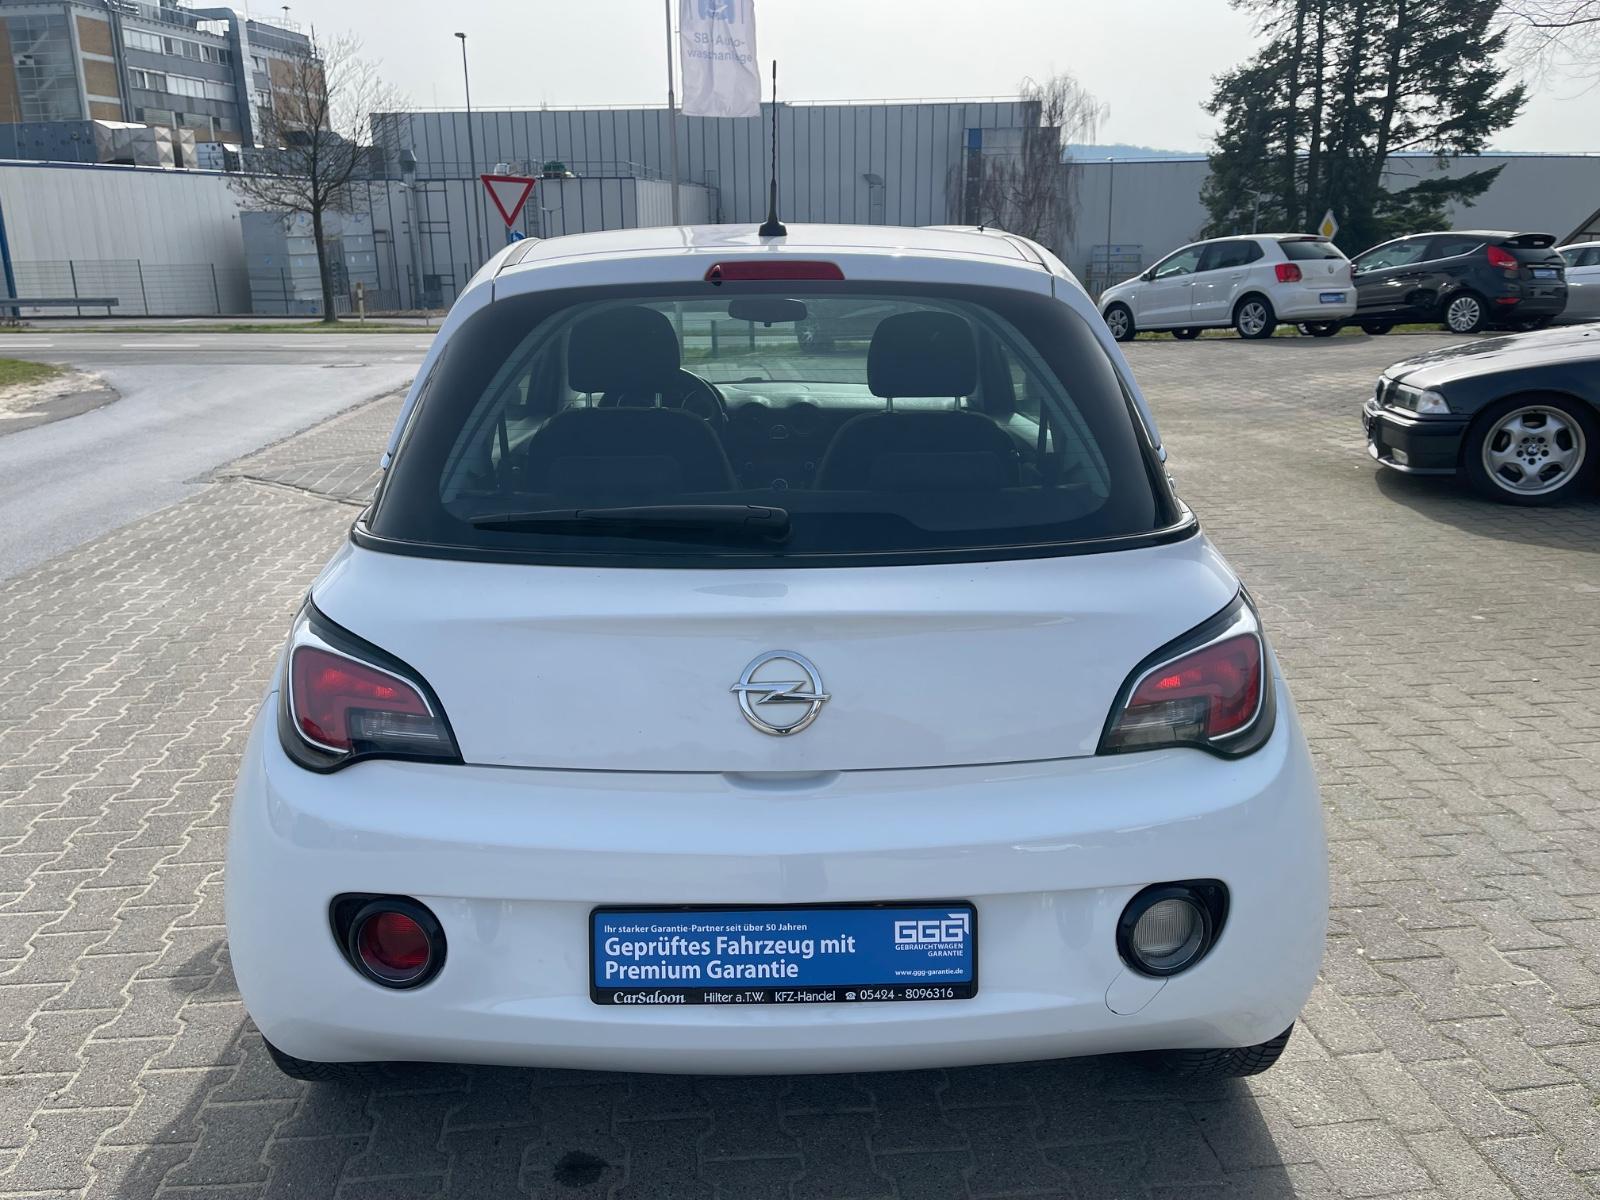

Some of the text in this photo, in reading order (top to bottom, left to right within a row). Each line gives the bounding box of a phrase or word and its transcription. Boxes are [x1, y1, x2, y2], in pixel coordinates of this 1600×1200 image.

[604, 923, 807, 933] Ihr starker Garantie-Partner seit über 50 Jahren
[894, 920, 963, 943] GGG
[604, 934, 856, 960] Geprüftes Fahrzeug mit
[895, 943, 964, 951] GEBRAUCHTWAGEN
[605, 959, 799, 980] Premium Garantie
[895, 968, 964, 977] www.ggg-garantie.de
[613, 990, 686, 1004] CarSaloon
[704, 992, 733, 1003] Hilter
[735, 991, 764, 1002] a.T.W.
[775, 990, 836, 1002] KFZ-Handel
[860, 989, 895, 1000] 05424
[905, 988, 954, 999] 8096316
